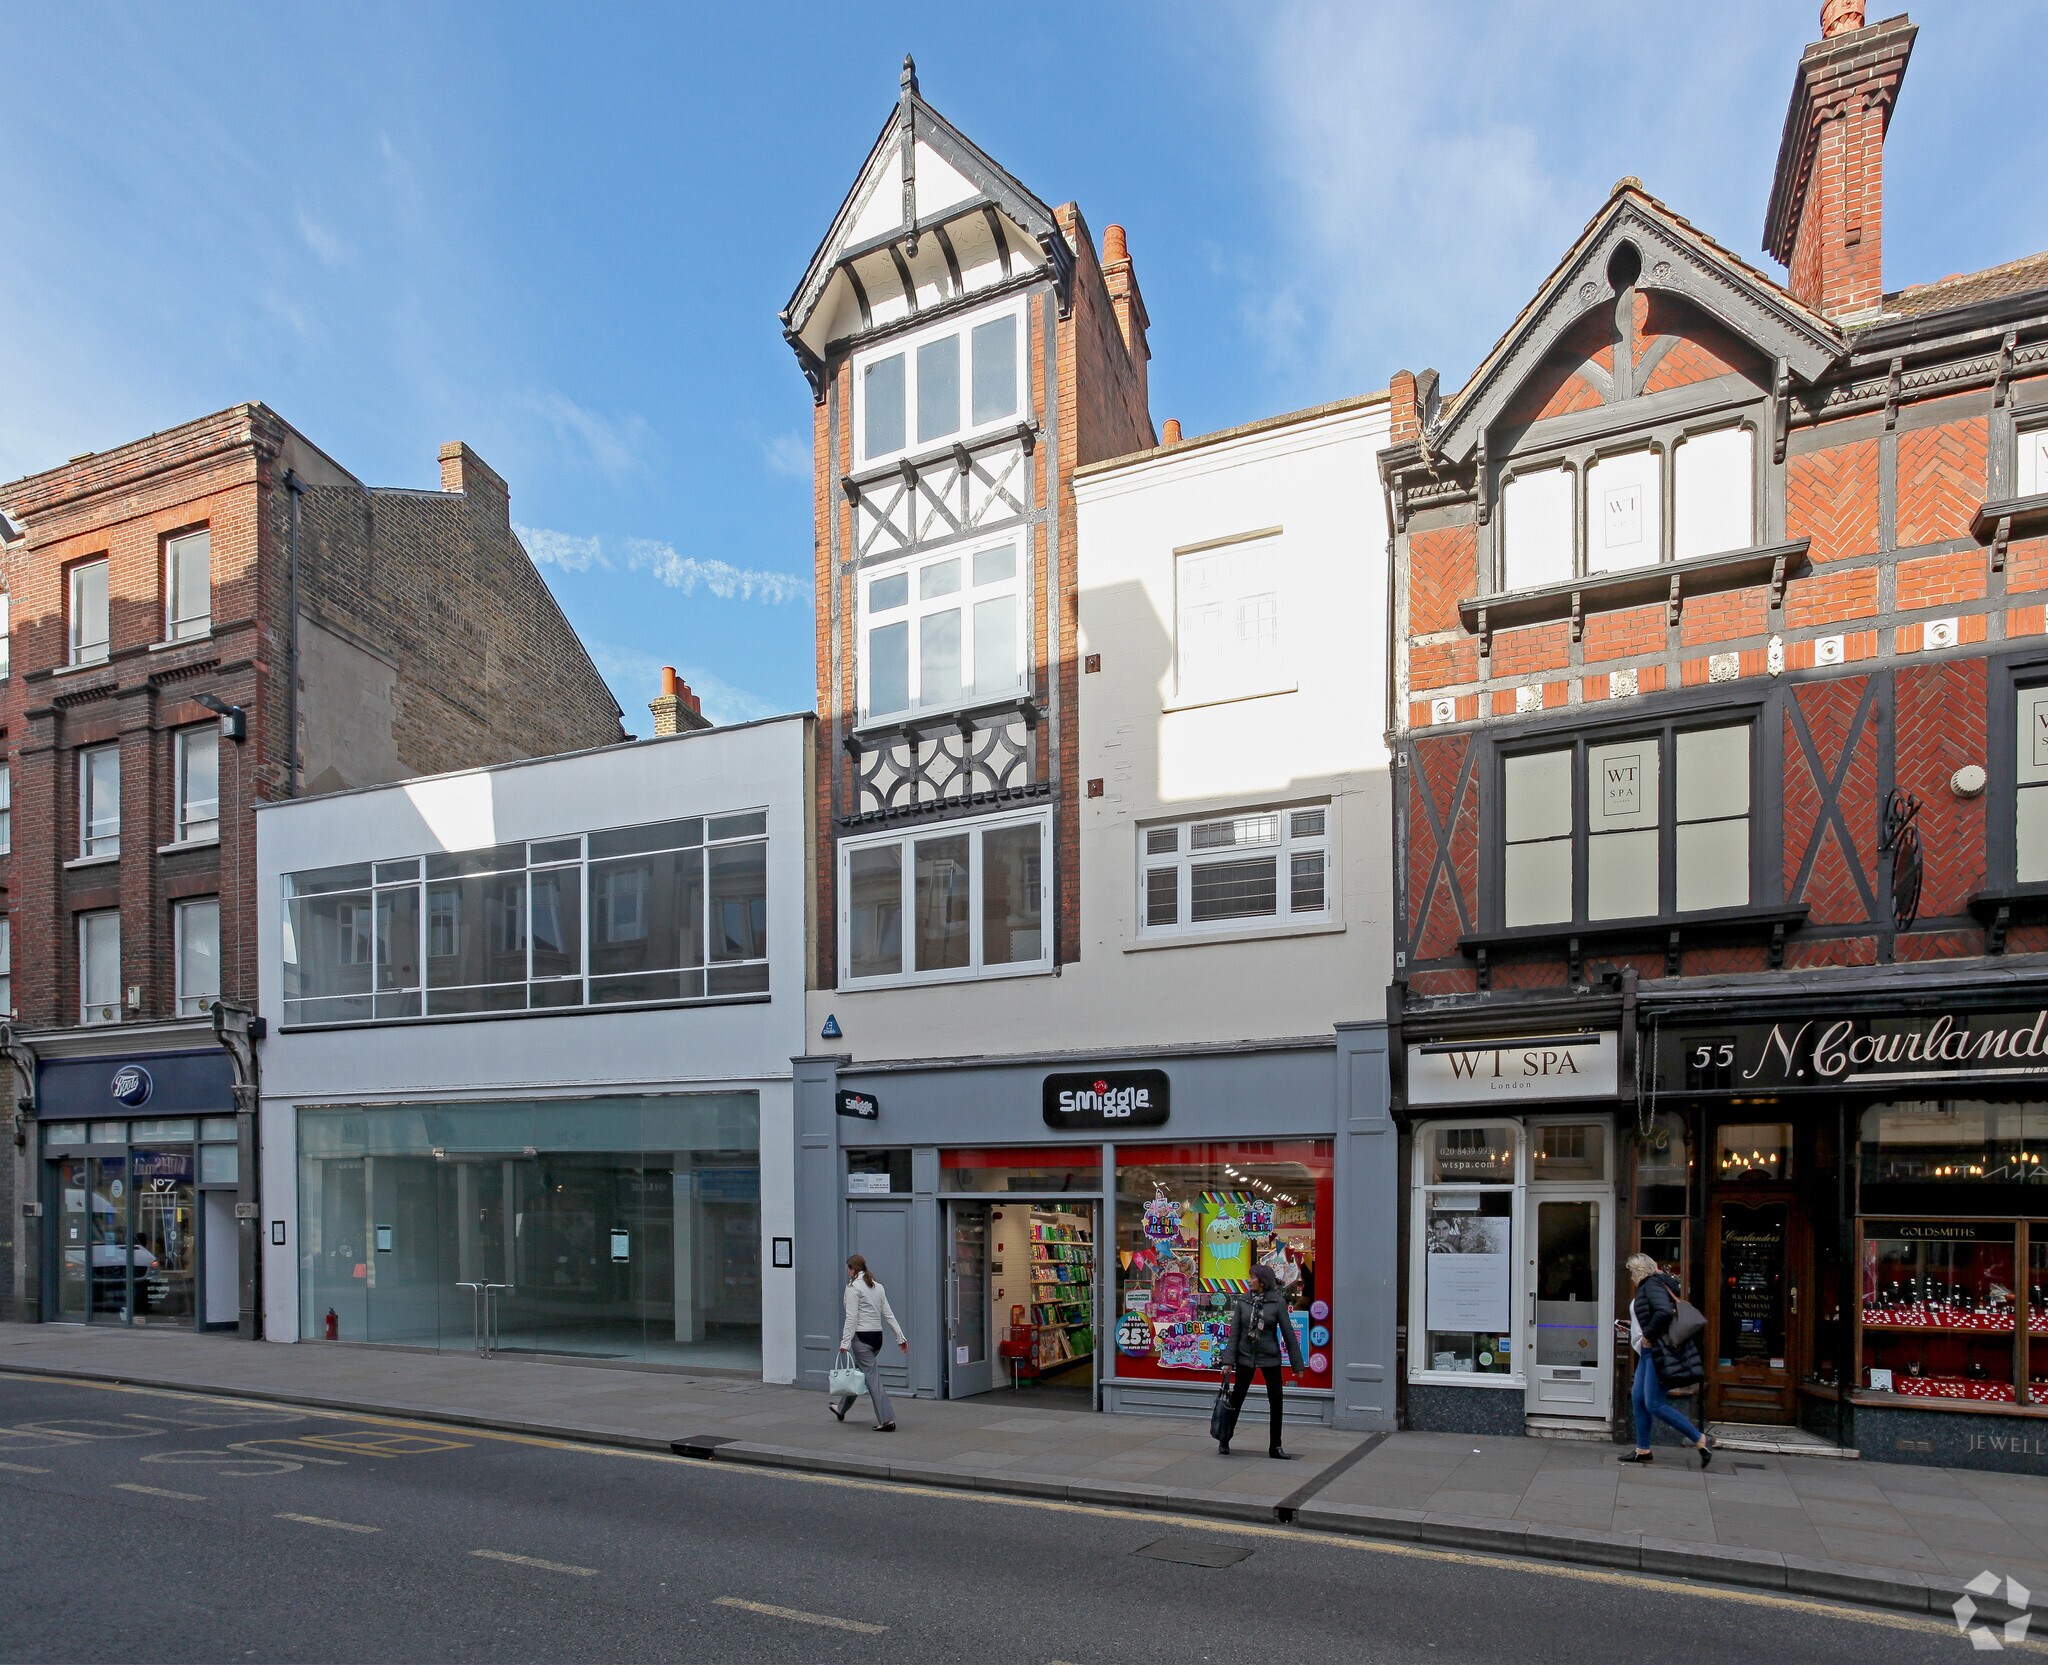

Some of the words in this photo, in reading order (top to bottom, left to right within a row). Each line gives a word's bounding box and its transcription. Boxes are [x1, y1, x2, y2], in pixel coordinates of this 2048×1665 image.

[1607, 766, 1638, 783] WT
[1610, 788, 1634, 798] SPA
[1692, 1044, 1735, 1069] 55
[1447, 1048, 1511, 1080] WT
[1522, 1049, 1580, 1077] SPA
[113, 1074, 140, 1098] Boots
[1490, 1081, 1531, 1090] London
[1059, 1081, 1150, 1118] smiggle
[1440, 1147, 1455, 1156] 020
[1457, 1147, 1476, 1156] 8439
[1441, 1161, 1495, 1170] wtspa.com
[1900, 1227, 1975, 1237] GOLDSMITHS
[1168, 1321, 1212, 1337] SMIGGLE
[1545, 1350, 1587, 1359] ENVIRON
